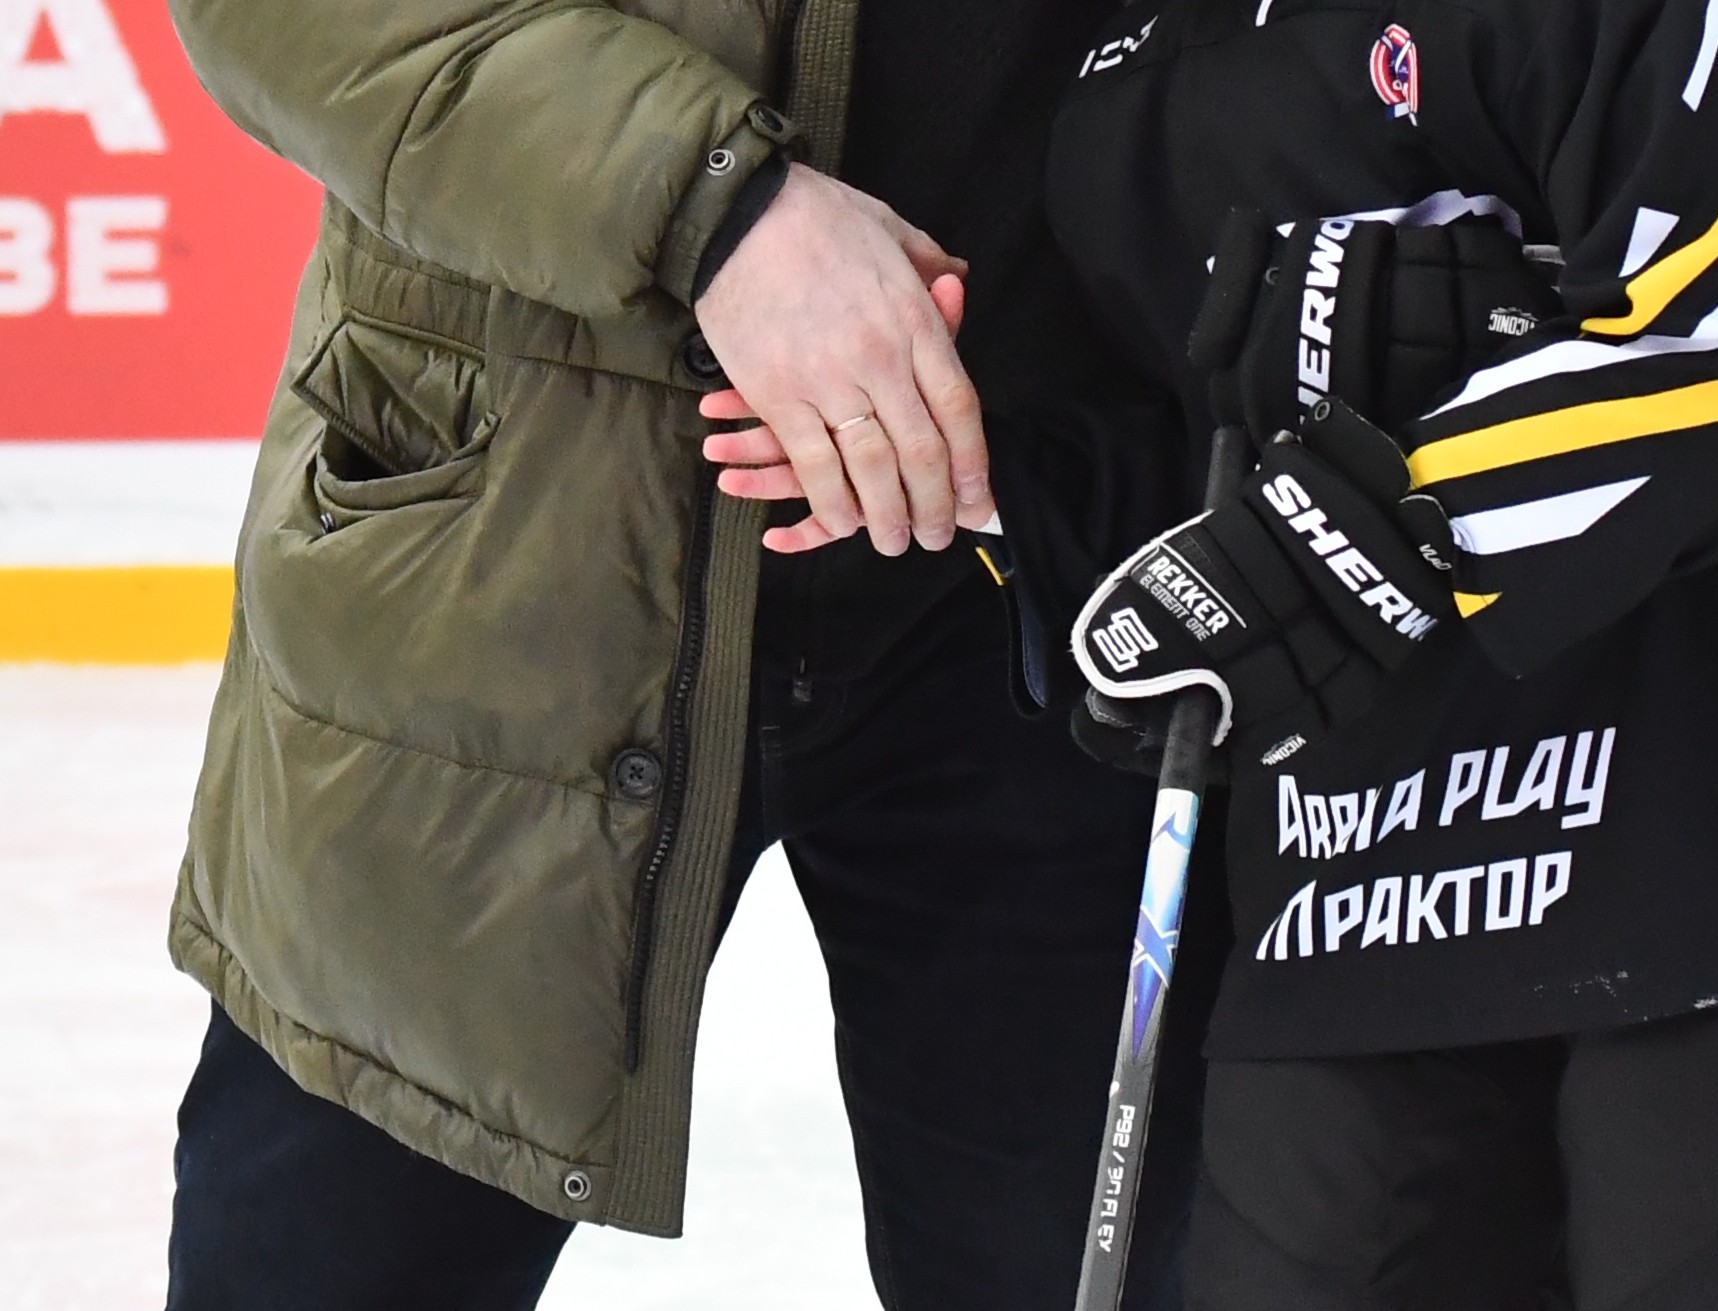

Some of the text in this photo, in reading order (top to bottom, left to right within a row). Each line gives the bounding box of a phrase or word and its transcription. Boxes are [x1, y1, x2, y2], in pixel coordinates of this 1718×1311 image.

[1139, 573, 1191, 620] ELEMENT
[1147, 555, 1230, 635] REKKER
[1438, 727, 1616, 829] PLAY
[1112, 1104, 1136, 1148] P92
